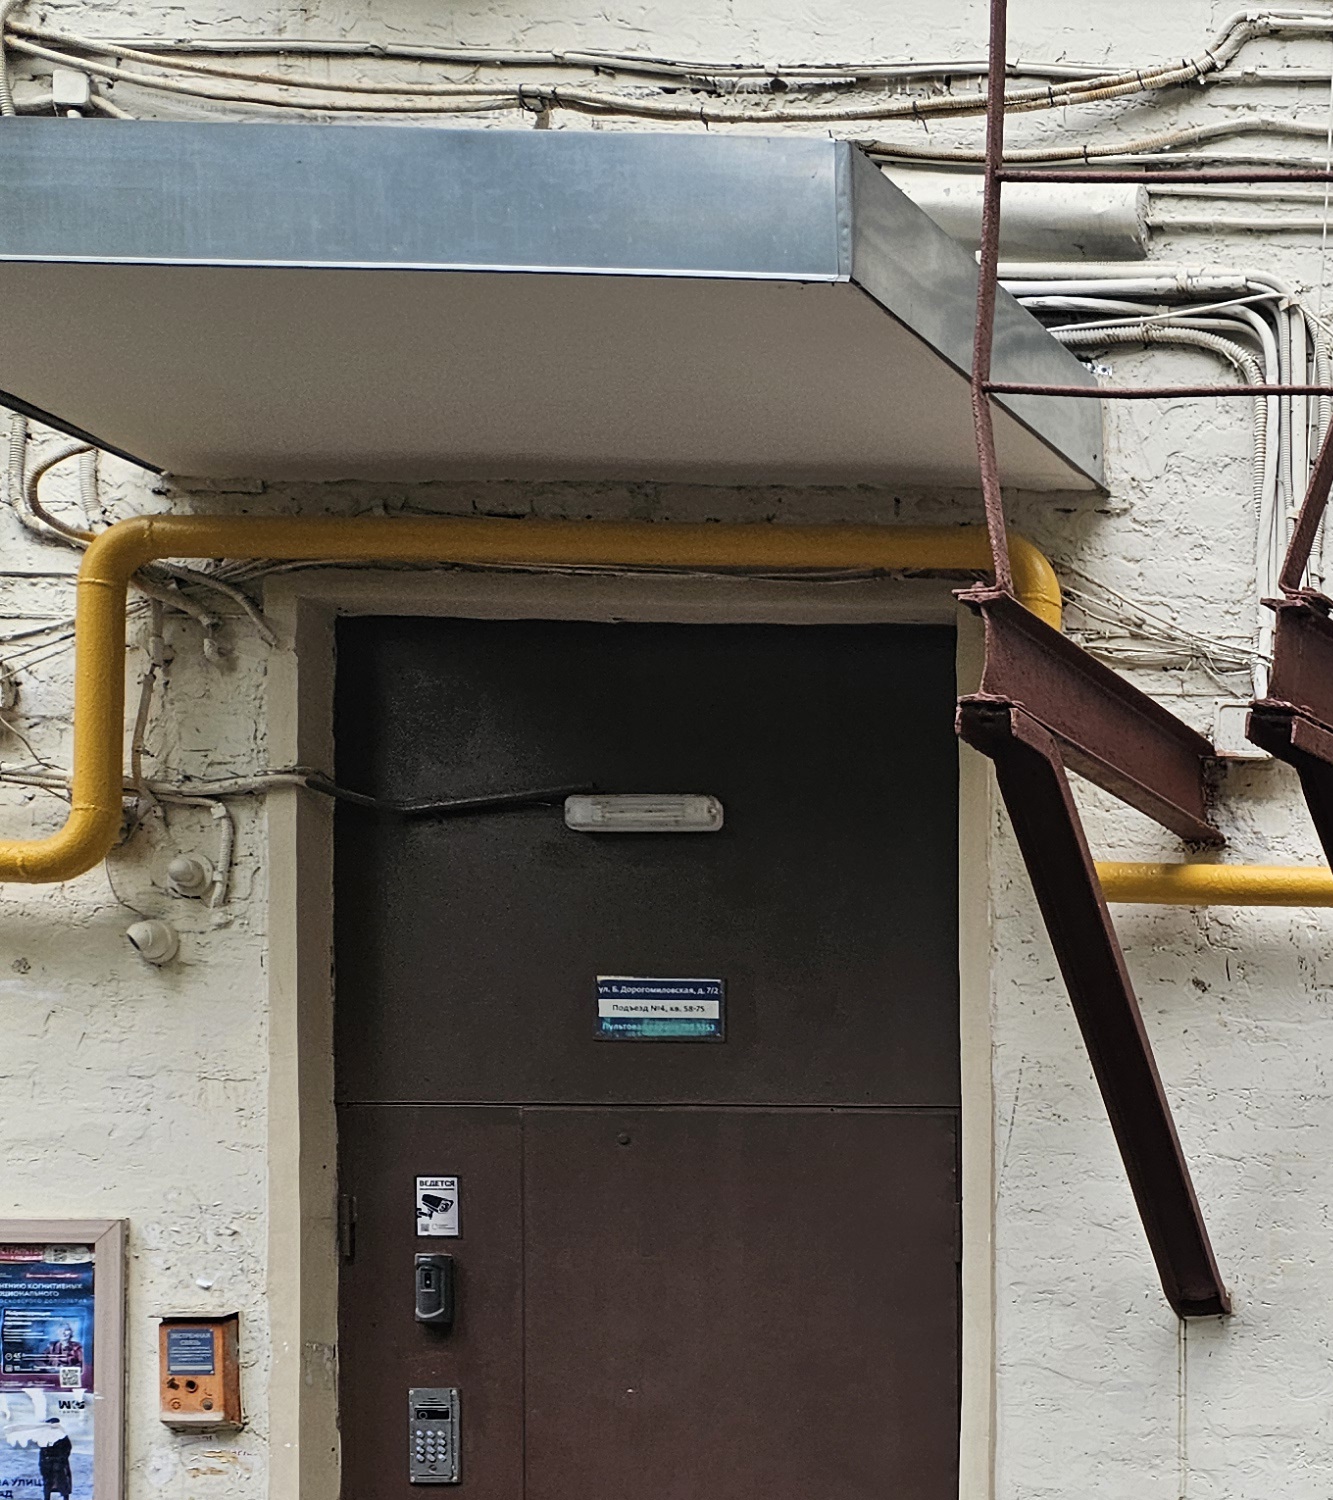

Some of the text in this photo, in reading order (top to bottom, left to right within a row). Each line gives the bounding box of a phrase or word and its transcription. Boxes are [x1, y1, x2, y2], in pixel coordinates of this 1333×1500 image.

[598, 987, 610, 995] ул.
[620, 986, 696, 995] Дорогомиловская,
[706, 987, 719, 995] 7/2
[612, 1004, 649, 1013] Подъезд
[669, 1005, 682, 1013] кв.
